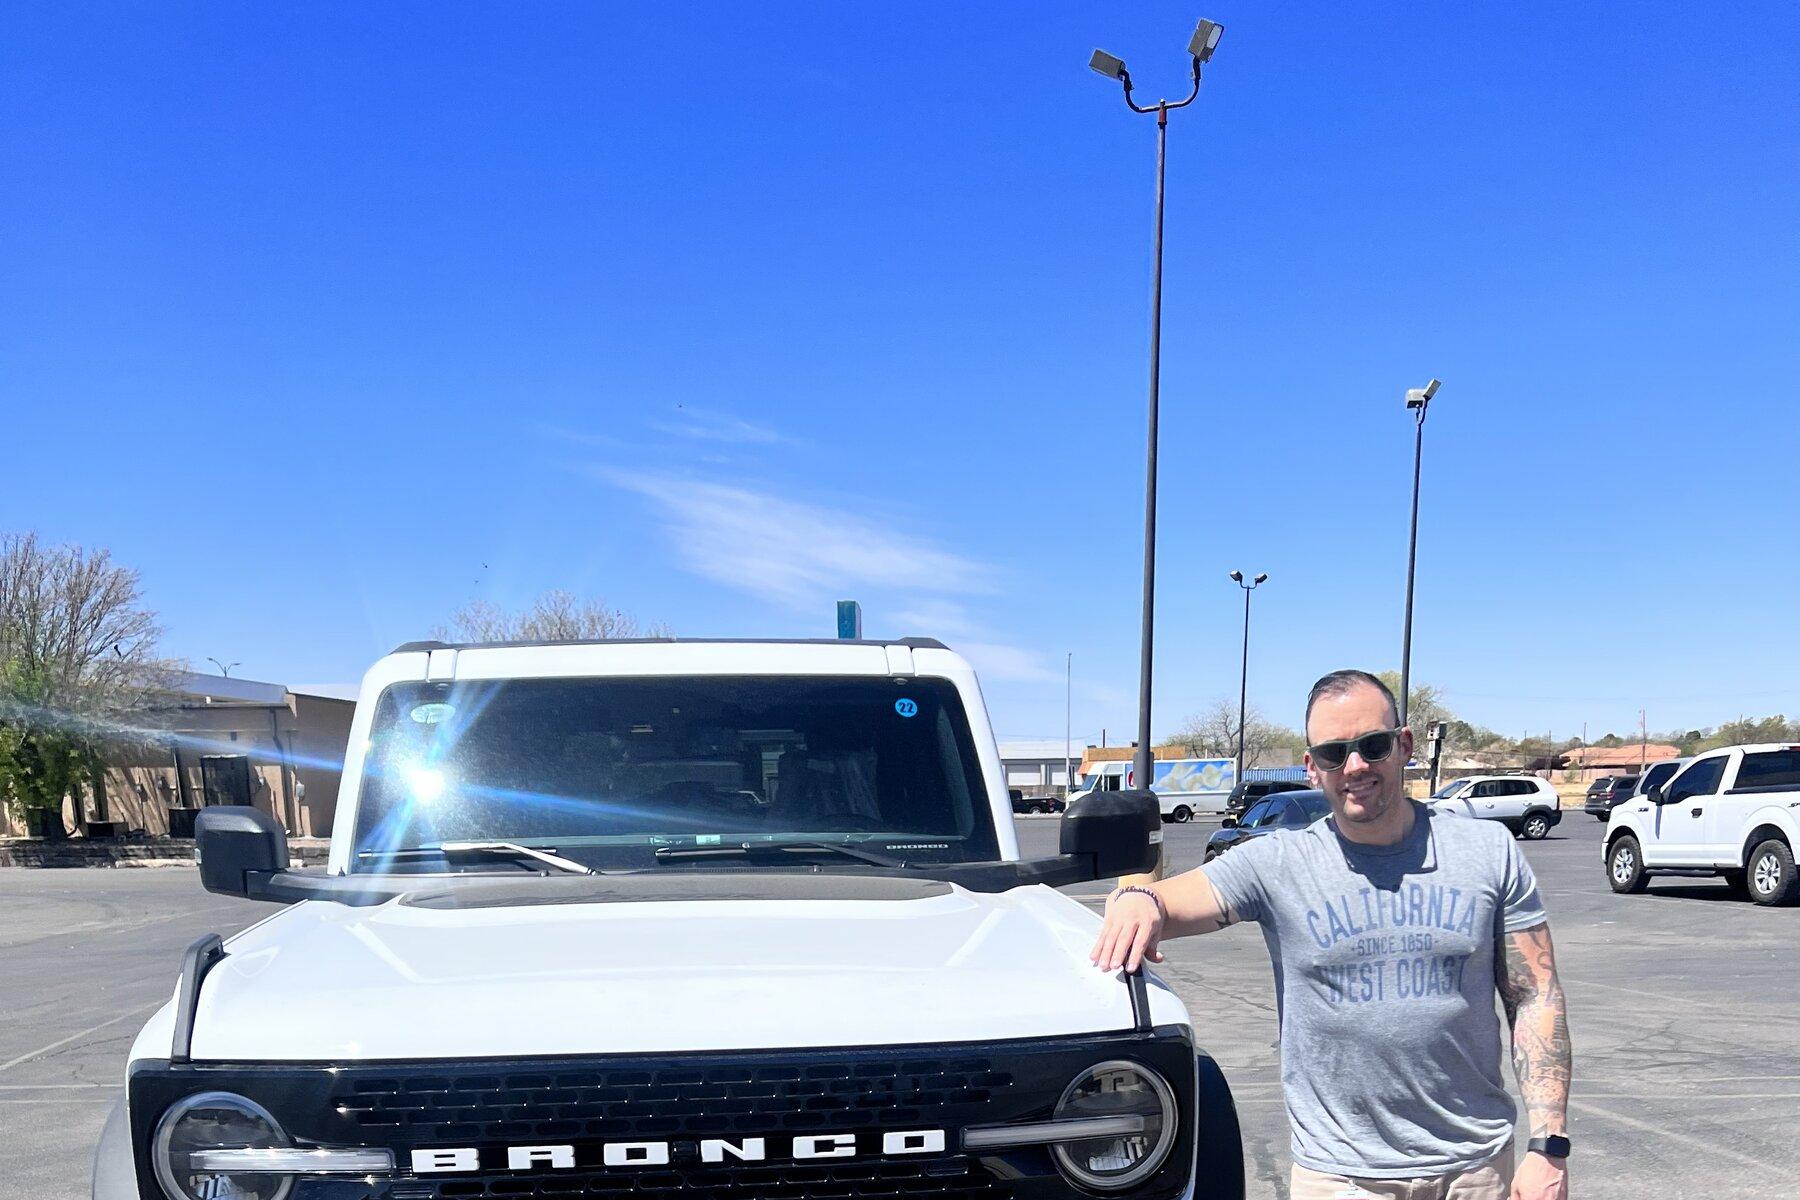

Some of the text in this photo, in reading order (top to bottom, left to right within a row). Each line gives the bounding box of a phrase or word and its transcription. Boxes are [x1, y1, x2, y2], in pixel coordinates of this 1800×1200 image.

[899, 702, 914, 713] 22
[1306, 883, 1477, 949] CALIFORNIA
[1397, 954, 1470, 999] COAST
[410, 1129, 947, 1173] BRONCO
